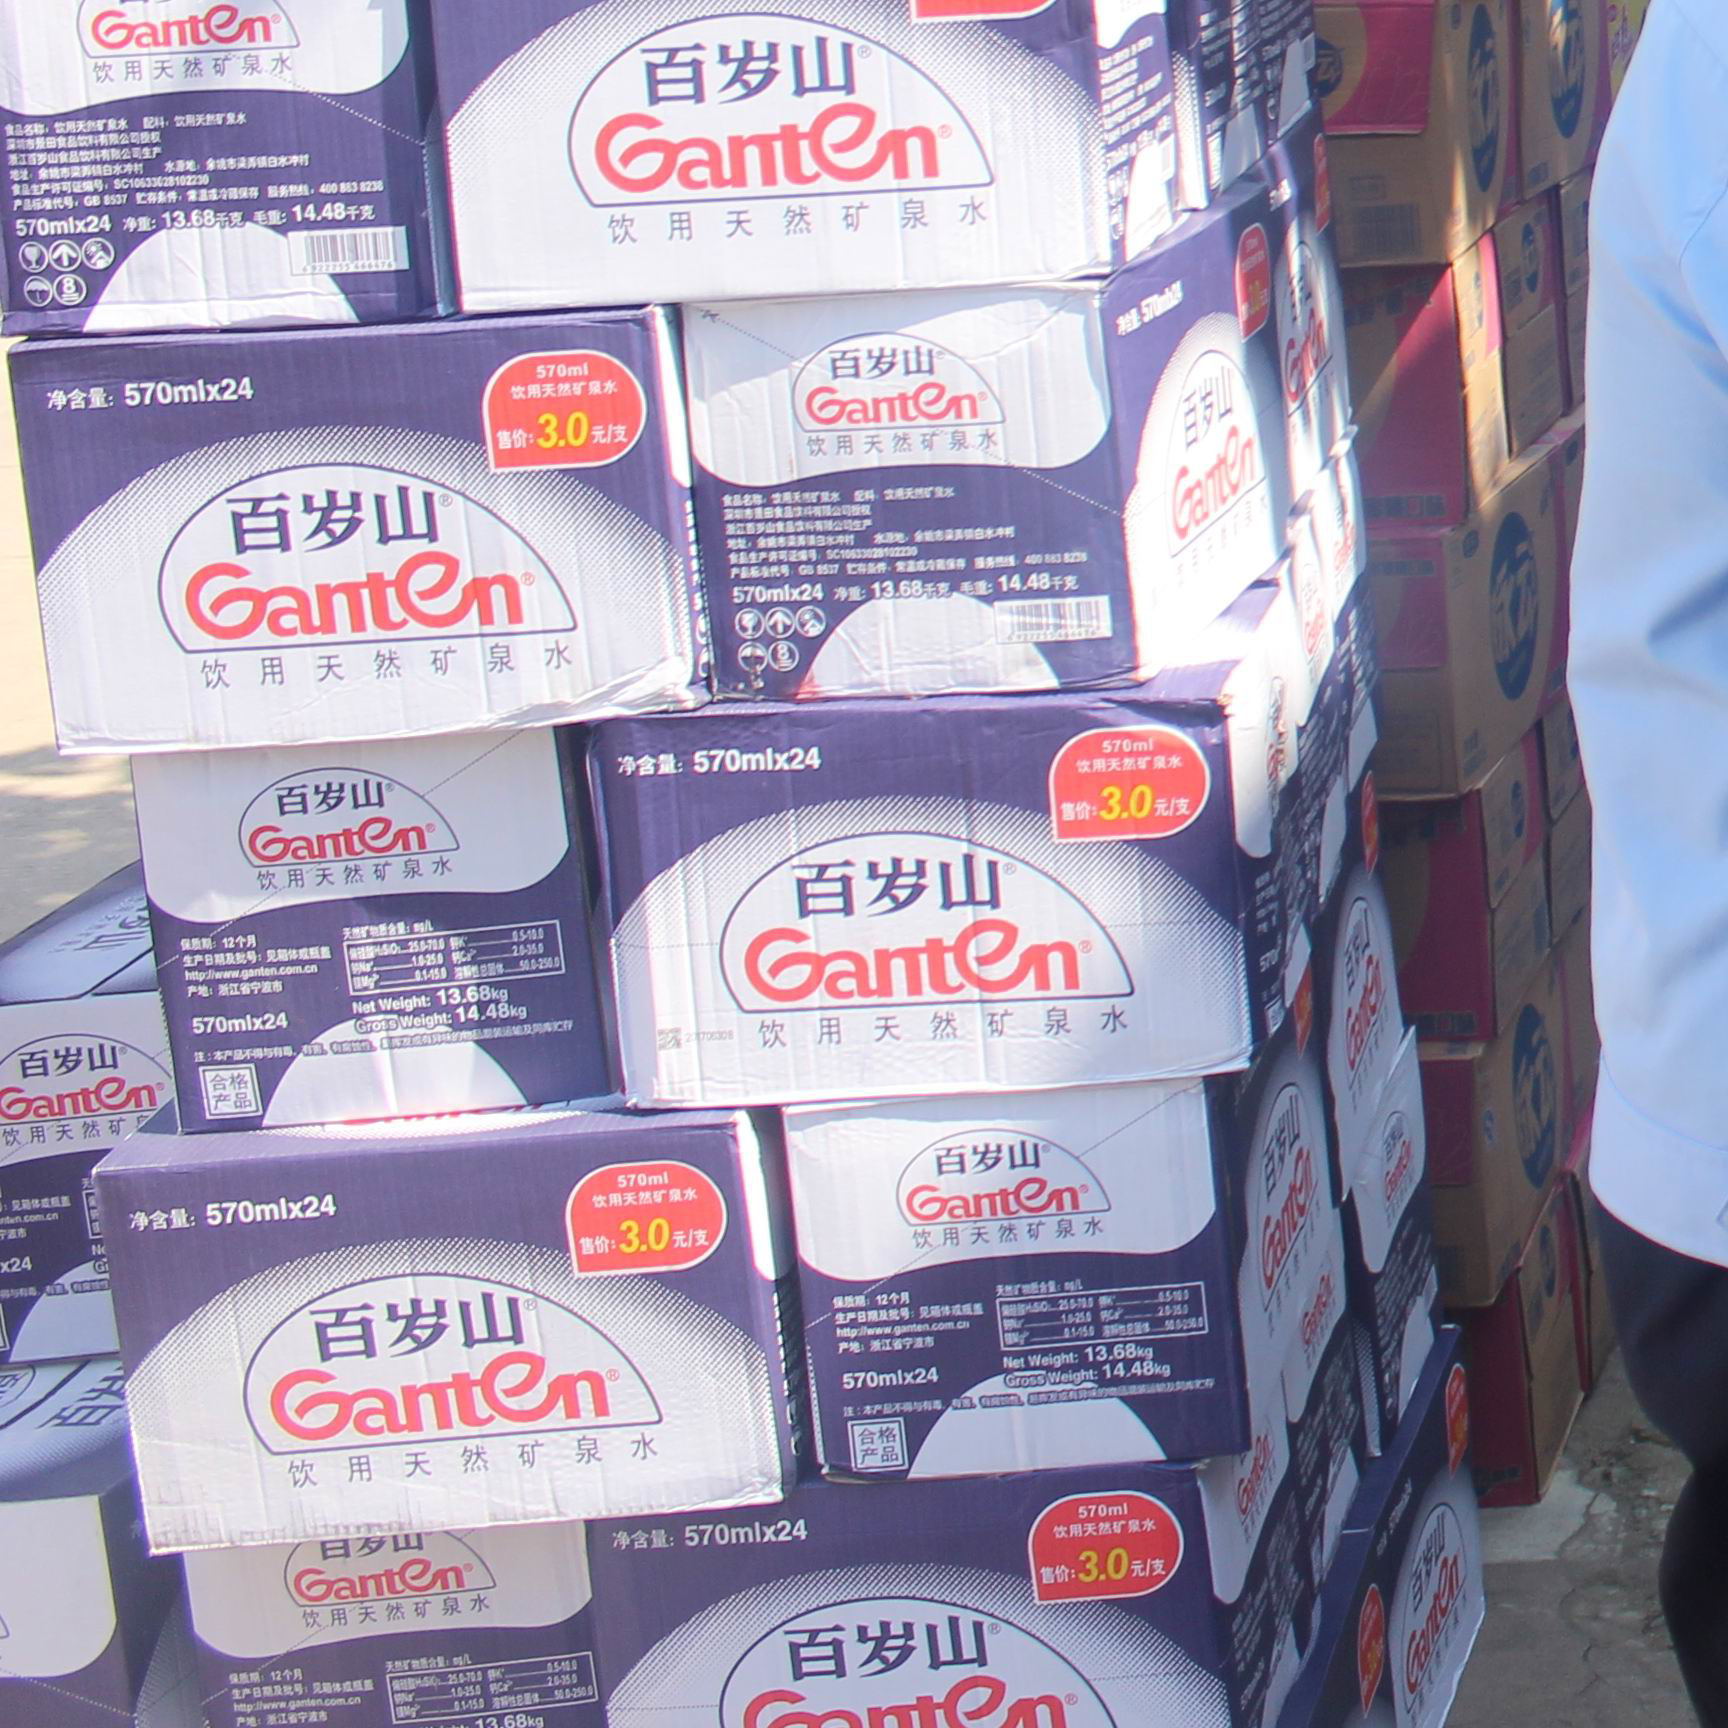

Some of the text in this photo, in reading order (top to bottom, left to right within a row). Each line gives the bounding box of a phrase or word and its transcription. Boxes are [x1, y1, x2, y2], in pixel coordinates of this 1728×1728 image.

[91, 4, 273, 51] Ganten
[92, 52, 294, 84] 饮用天然矿泉水
[640, 35, 855, 106] 百岁山
[594, 101, 940, 194] Ganten
[15, 215, 112, 237] 570mlx24
[607, 195, 988, 245] 饮用天然矿泉水
[828, 345, 936, 381] 百岁山
[124, 376, 254, 408] 570mlx24
[805, 381, 979, 426] Ganten
[806, 427, 999, 459] 饮用天然矿泉水
[225, 484, 440, 555] 百岁山
[184, 550, 524, 641] Ganten
[732, 582, 824, 604] 570mlx24
[199, 639, 574, 690] 饮用天然矿泉水
[692, 747, 822, 774] 570mlx24
[275, 778, 385, 817] 百岁山
[248, 816, 427, 863] Ganten
[256, 855, 453, 892] 饮用天然矿泉水
[791, 853, 1004, 920] 百岁山
[743, 917, 1080, 1004] Ganten
[352, 985, 510, 1015] Net Weight: 13.68kg
[356, 1003, 528, 1035] Gross Weight: 14.48kg
[191, 1011, 289, 1035] 570mlx24
[758, 1005, 1130, 1049] 饮用天然矿泉水
[18, 1042, 120, 1080] 百岁山
[933, 1140, 1042, 1177] 百岁山
[204, 1196, 337, 1227] 570mlx24
[904, 1176, 1080, 1223] Ganten
[911, 1216, 1105, 1250] 饮用天然矿泉水
[309, 1289, 527, 1363] 百岁山
[1002, 1342, 1154, 1370] Net Weight: 13.68kg
[1003, 1361, 1172, 1389] Gross Weight: 14.48kg
[268, 1350, 611, 1442] Ganten
[841, 1367, 940, 1391] 570mlx24
[286, 1431, 660, 1489] 饮用天然矿泉水
[683, 1518, 808, 1548] 570mlx24
[293, 1556, 466, 1605] Ganten
[302, 1592, 491, 1630] 饮用天然矿泉水
[783, 1615, 990, 1681] 百岁山
